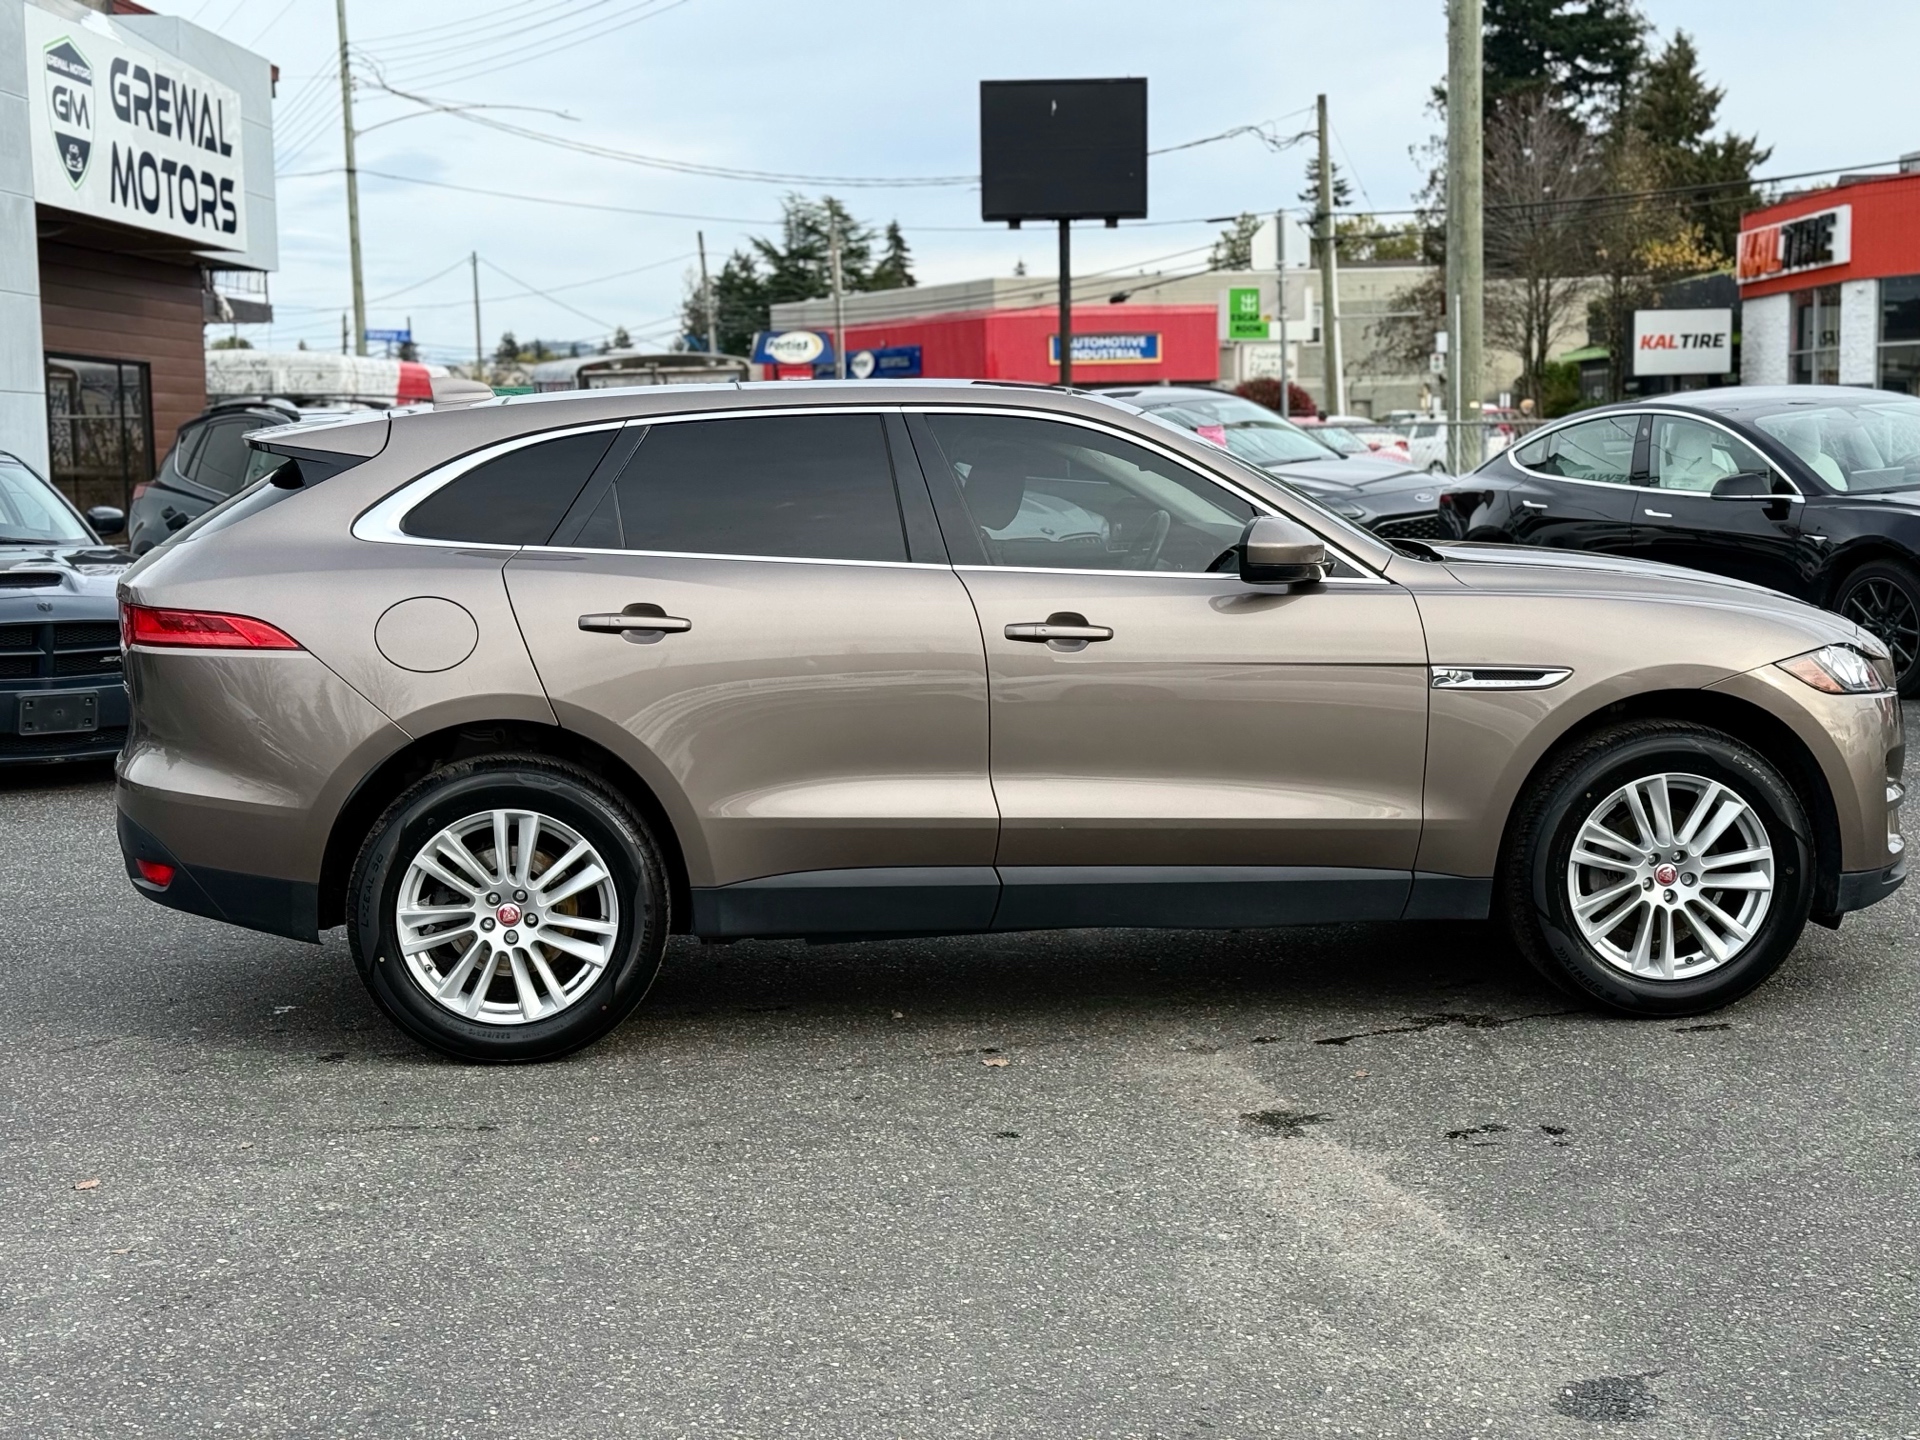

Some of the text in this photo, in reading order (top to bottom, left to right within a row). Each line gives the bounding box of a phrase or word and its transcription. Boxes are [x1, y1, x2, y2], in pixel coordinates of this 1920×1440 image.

[46, 53, 91, 81] GREWAL MOTORS
[52, 85, 90, 130] GM
[110, 56, 233, 158] GREWAL
[110, 140, 237, 234] MOTORS
[1741, 212, 1837, 279] KAL TIRE
[1640, 333, 1726, 350] KAL TIRE
